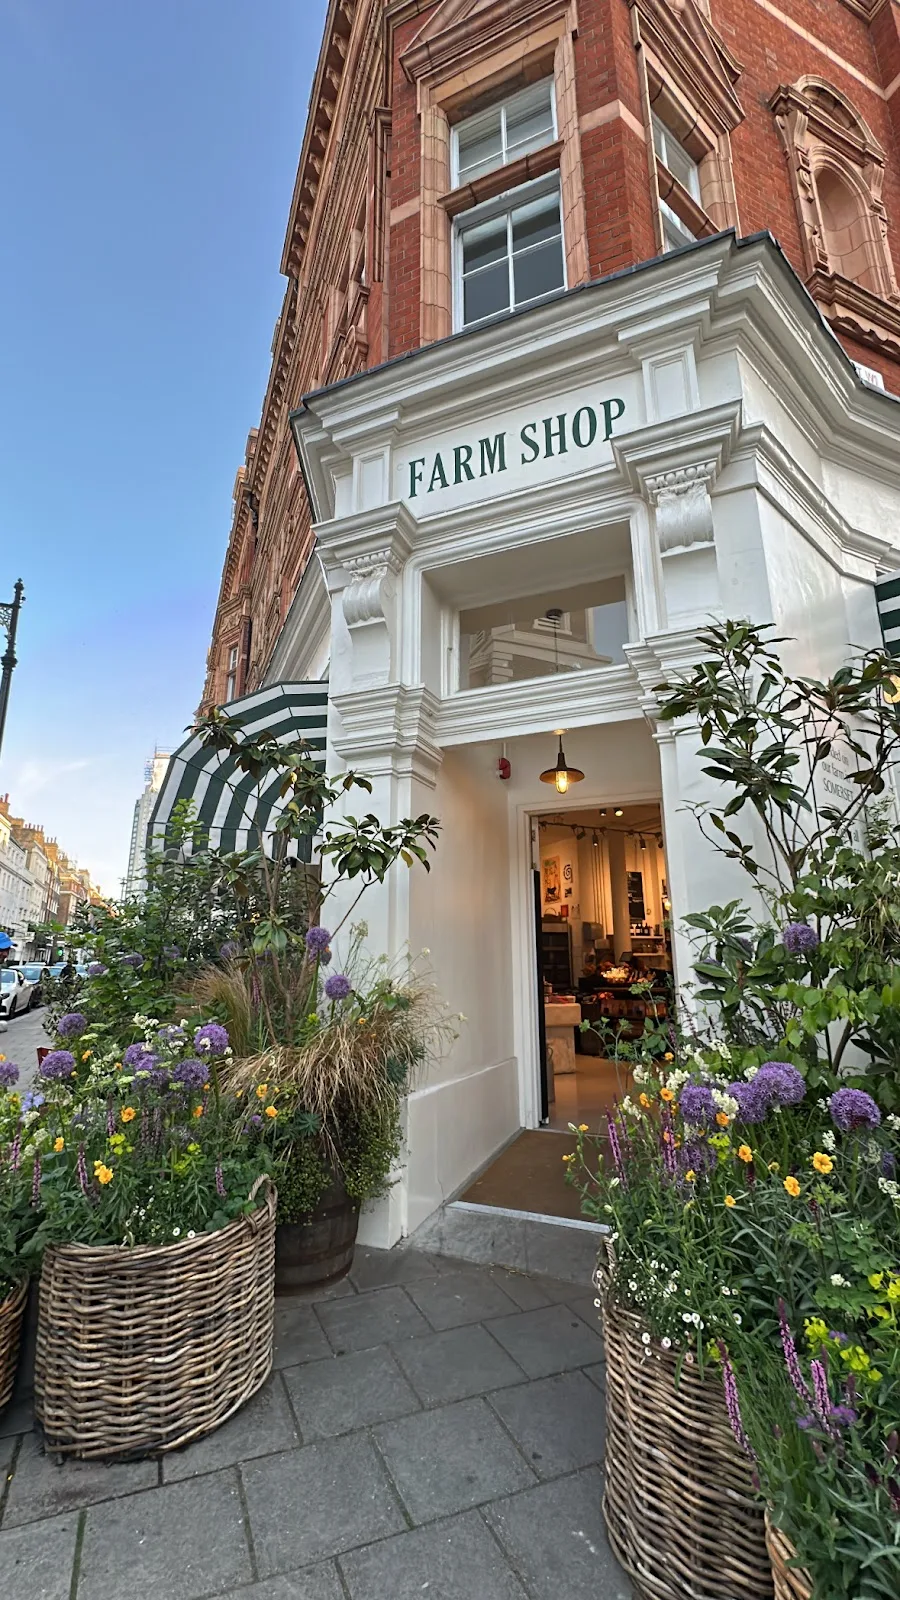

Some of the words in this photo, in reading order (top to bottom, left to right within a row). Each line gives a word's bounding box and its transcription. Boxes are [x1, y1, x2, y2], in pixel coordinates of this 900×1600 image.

[408, 431, 508, 499] FARM
[520, 398, 626, 465] SHOP
[823, 777, 854, 802] SOMERSET
